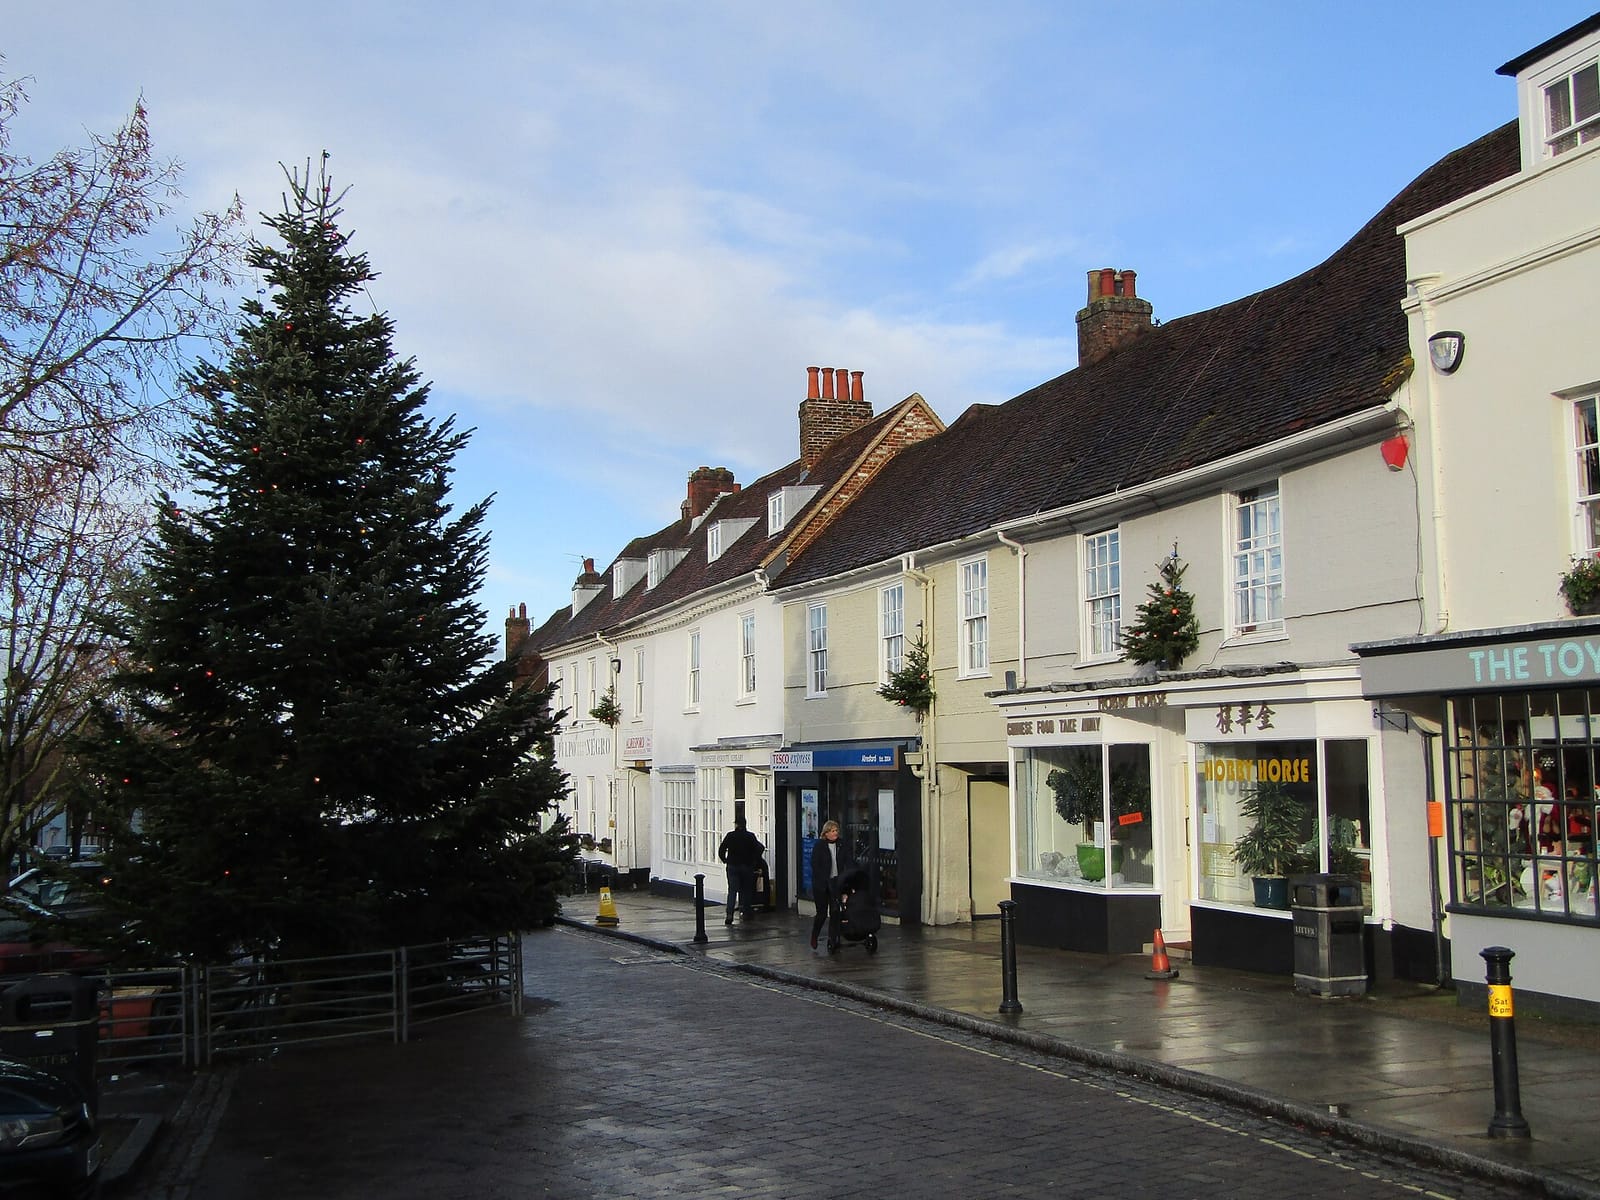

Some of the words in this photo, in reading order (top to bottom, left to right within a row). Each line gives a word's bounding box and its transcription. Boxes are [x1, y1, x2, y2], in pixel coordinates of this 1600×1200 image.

[1468, 647, 1530, 682] THE
[1537, 640, 1600, 678] TOY
[1006, 721, 1033, 736] CHINESE
[1037, 720, 1055, 735] FOOD
[1059, 718, 1077, 733] TAKE
[1081, 717, 1101, 732] AWAY
[772, 753, 790, 765] TESCO
[790, 753, 811, 767] express
[1204, 758, 1254, 783] HOBBY
[1257, 758, 1310, 783] HORSE
[1494, 998, 1508, 1006] Sat
